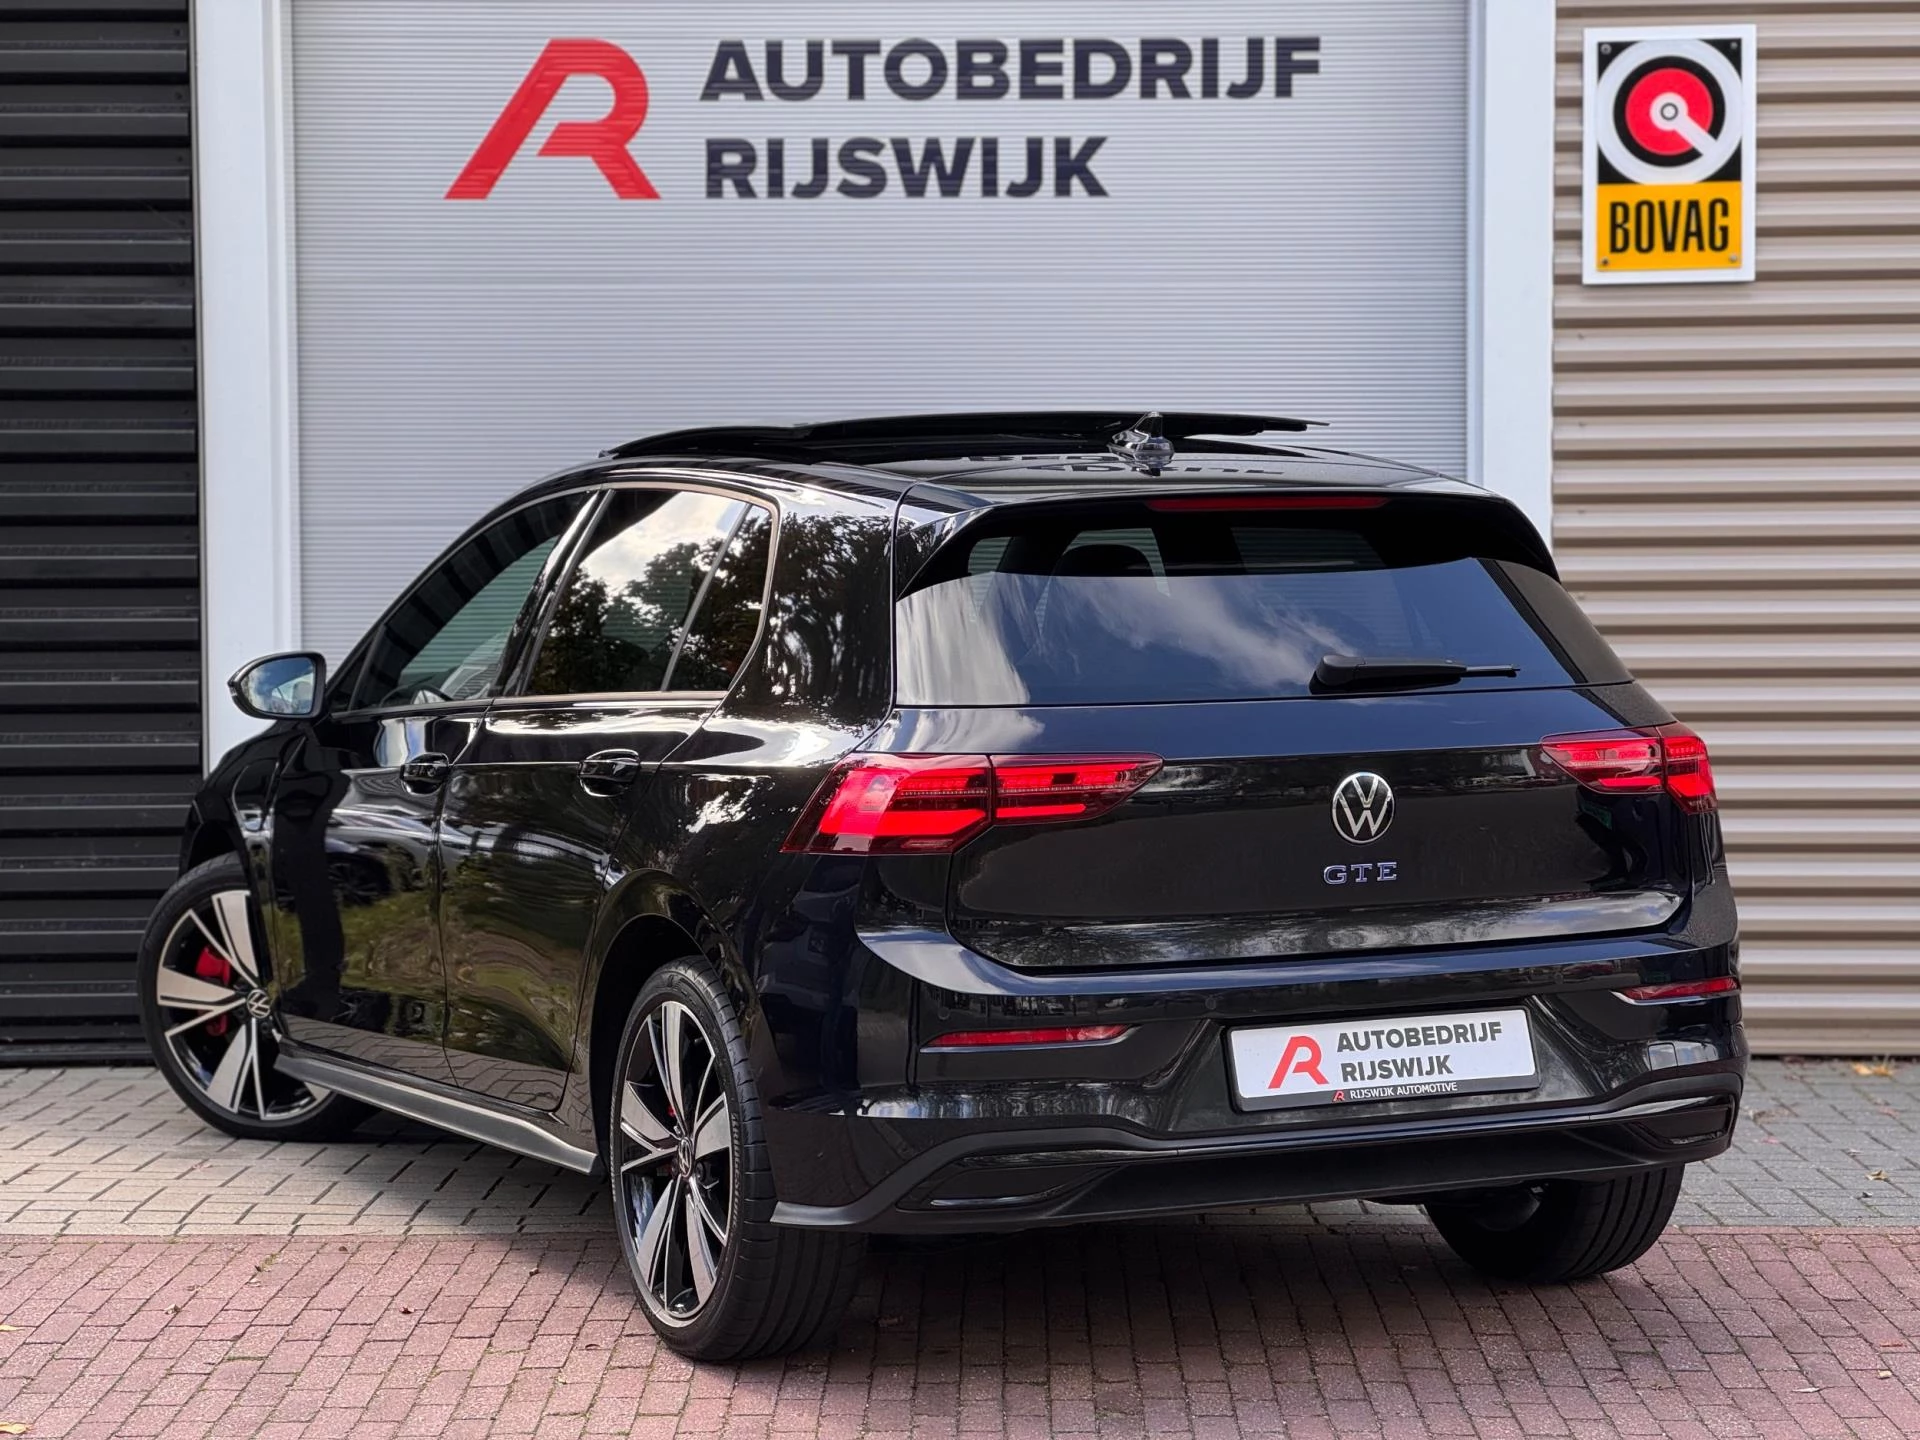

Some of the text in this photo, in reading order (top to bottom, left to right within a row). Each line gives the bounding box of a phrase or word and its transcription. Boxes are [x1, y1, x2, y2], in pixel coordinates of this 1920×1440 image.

[700, 37, 1320, 101] AUTOBEDRIJF
[705, 136, 1108, 199] RIJSWIJK
[1610, 198, 1730, 254] BOVAG
[1323, 861, 1398, 885] GTE
[1337, 1022, 1502, 1052] AUTOBEDRIJF
[1341, 1055, 1453, 1082] RIJSWIJK
[1350, 1081, 1458, 1100] RIJSWIJK AUTOMOTIVE
